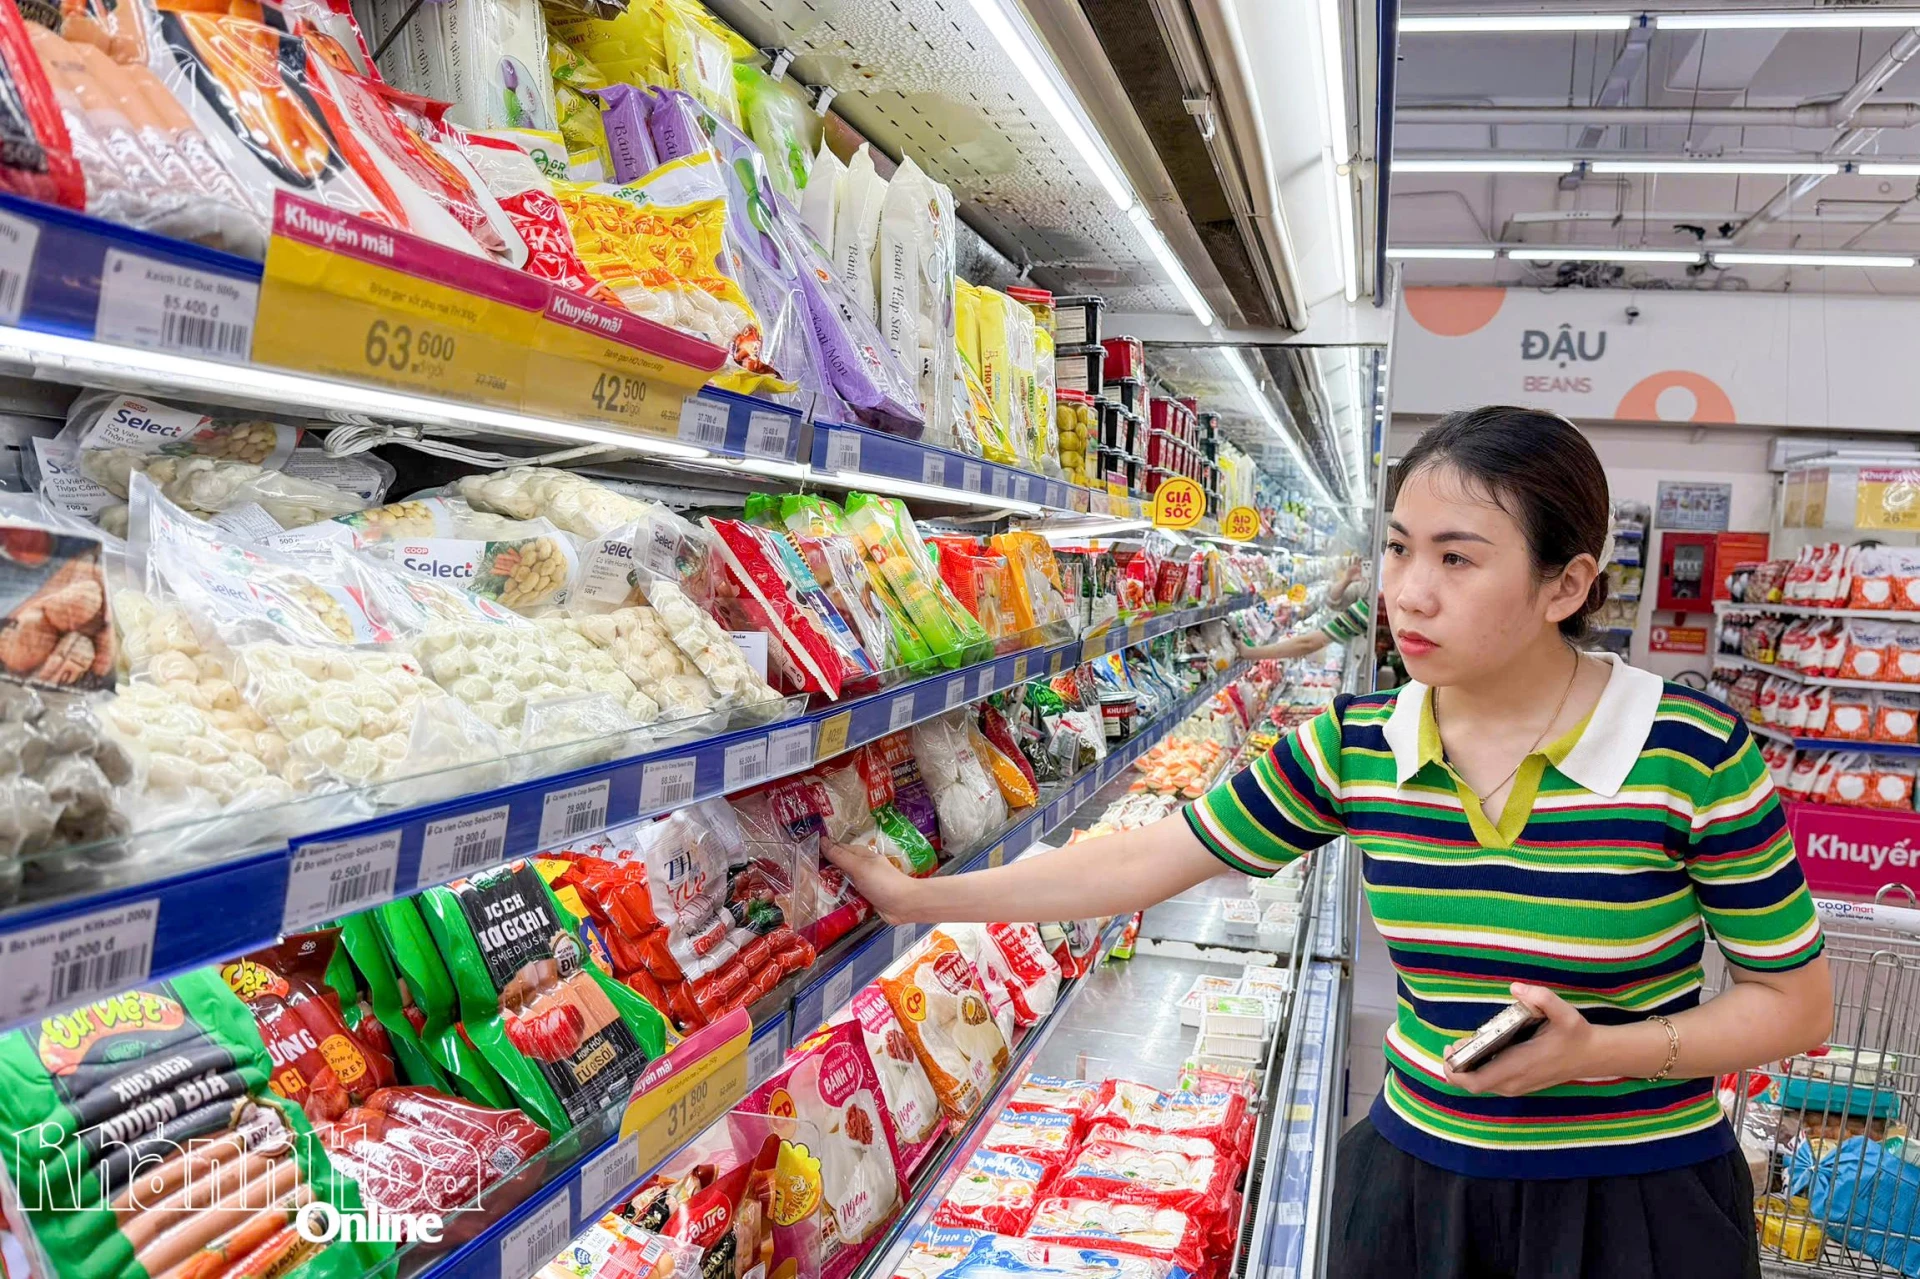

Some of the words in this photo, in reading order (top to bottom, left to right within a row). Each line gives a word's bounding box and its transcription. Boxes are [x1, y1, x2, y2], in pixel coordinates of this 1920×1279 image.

[613, 121, 633, 170] Bánh
[284, 205, 358, 247] Khuyến
[361, 235, 395, 258] mãi
[892, 242, 905, 281] Bánh
[552, 296, 598, 328] Khuyến
[599, 313, 622, 333] mãi
[418, 331, 456, 361] 600
[1521, 323, 1607, 369] ĐẬU
[623, 379, 647, 401] 500
[1523, 376, 1592, 393] BEANS
[113, 409, 182, 438] Select
[1166, 487, 1191, 503] GIÁ
[1165, 504, 1192, 518] SỐC
[404, 546, 429, 554] COOP
[601, 540, 633, 559] Selec
[655, 531, 675, 551] Select
[403, 558, 473, 578] Select
[474, 814, 492, 827] Select
[480, 829, 486, 841] đ
[355, 845, 378, 860] Select
[363, 861, 370, 873] đ
[105, 937, 116, 952] đ
[907, 992, 922, 1014] CP
[690, 1081, 708, 1107] 800
